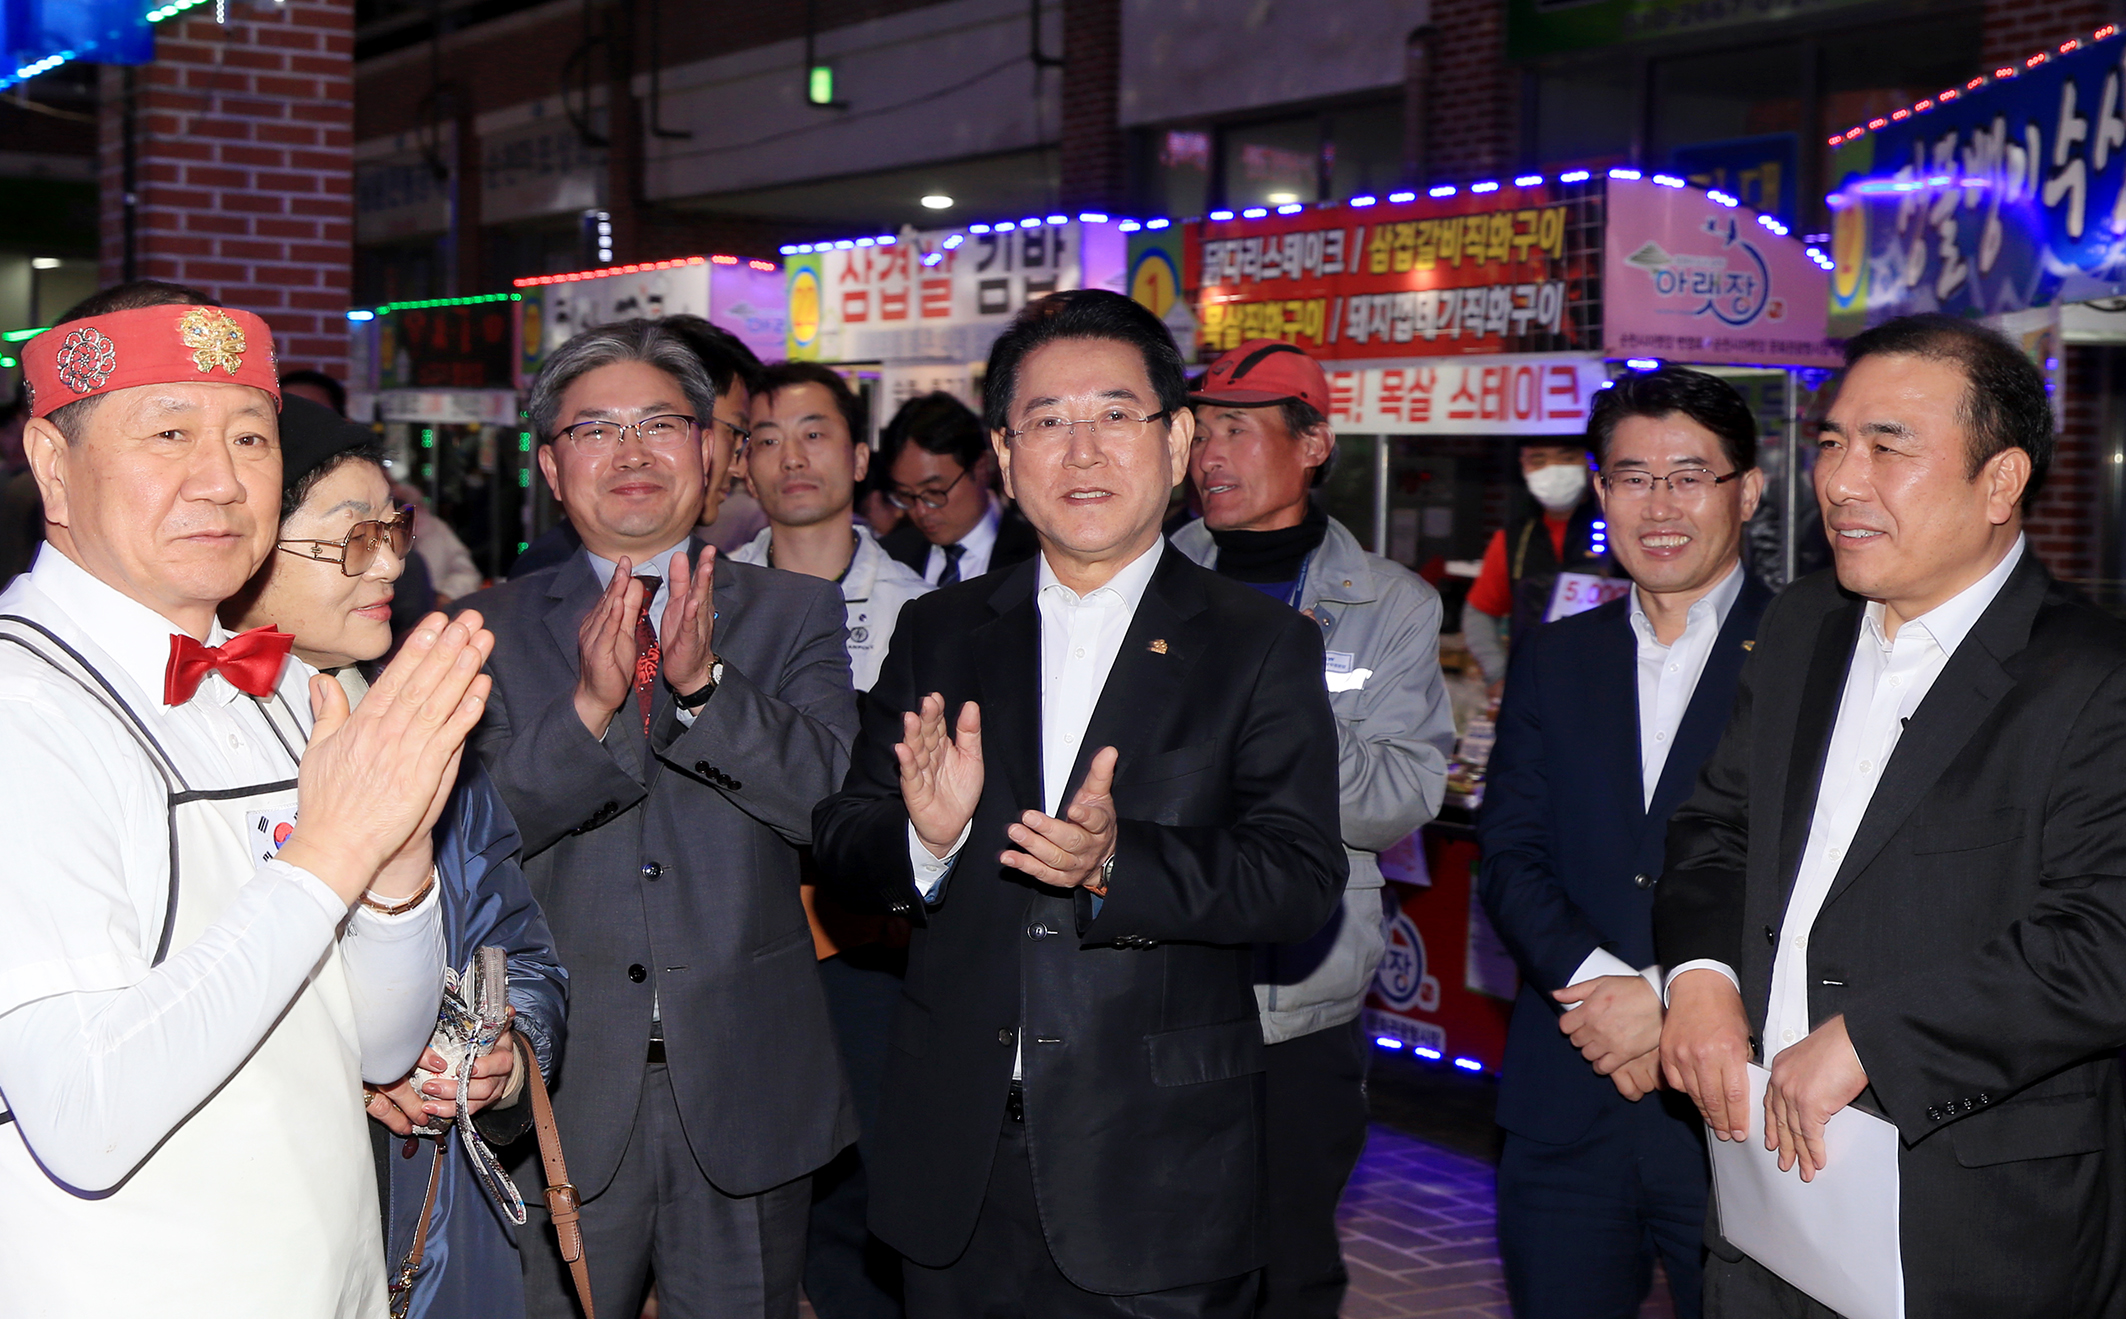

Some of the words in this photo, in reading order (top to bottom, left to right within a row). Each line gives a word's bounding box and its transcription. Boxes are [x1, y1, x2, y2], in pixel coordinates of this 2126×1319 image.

[1201, 226, 1346, 287] 닭다리스테이크
[1368, 206, 1568, 275] 삼겹갈비직화구이
[840, 240, 958, 322] 삼겹살
[977, 229, 1067, 315] 김밥
[1655, 268, 1760, 318] 아랫장
[1201, 297, 1327, 352] 목살직화구이
[1329, 370, 1365, 423] 득!
[1378, 369, 1436, 422] 목살
[1448, 366, 1584, 421] 스테이크
